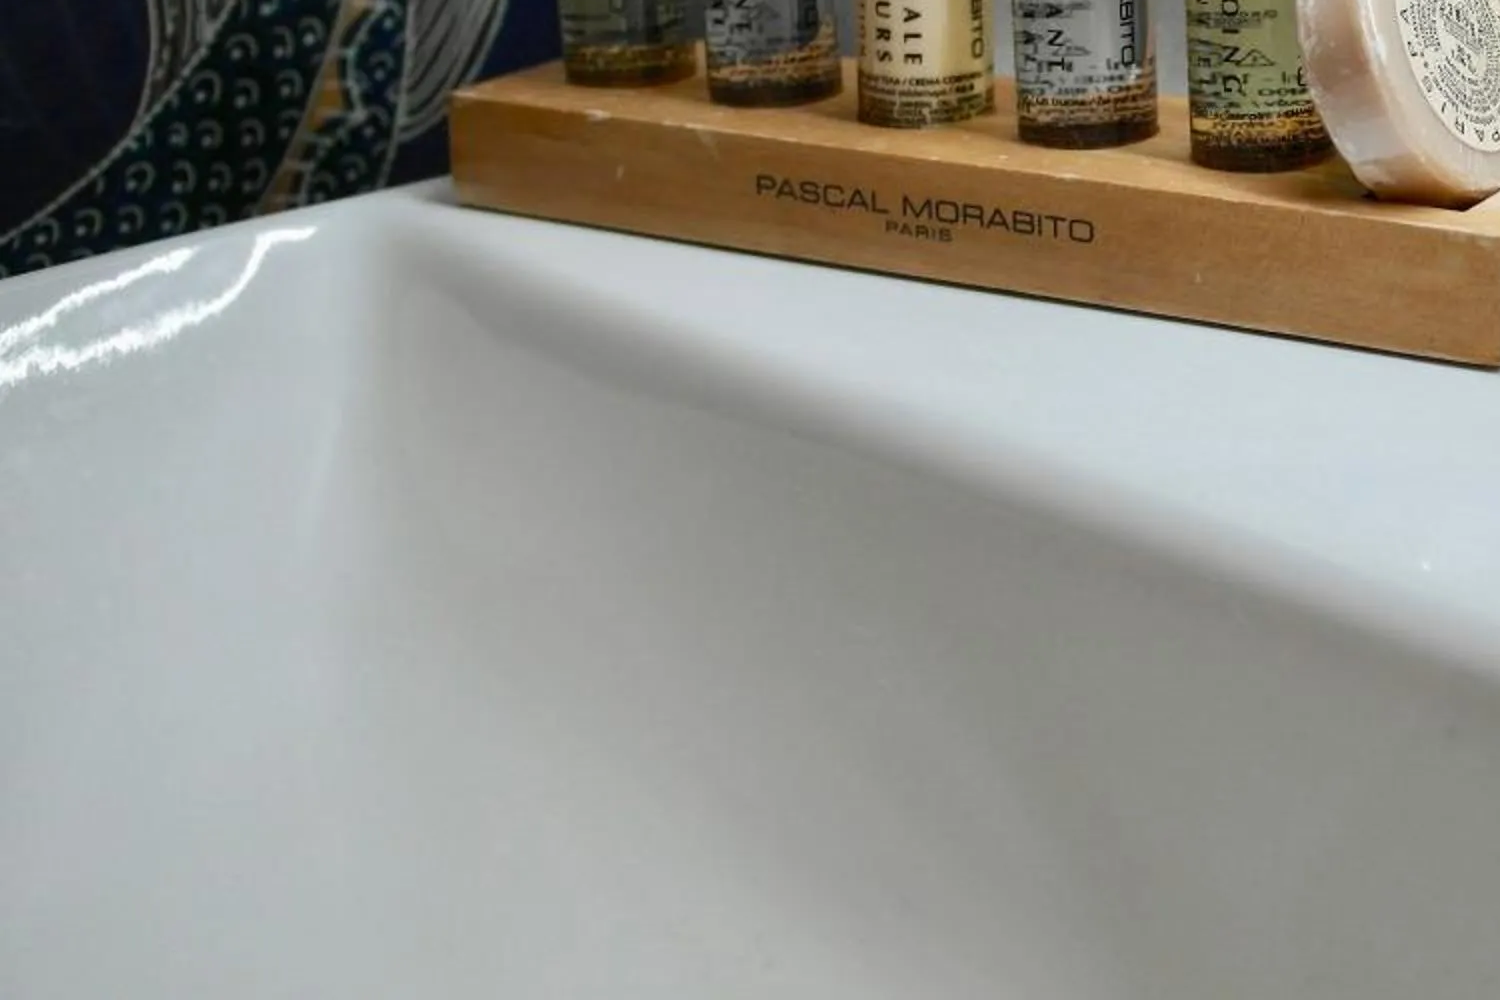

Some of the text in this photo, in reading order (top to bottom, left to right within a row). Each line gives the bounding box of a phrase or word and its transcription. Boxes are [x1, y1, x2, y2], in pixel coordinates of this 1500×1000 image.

[756, 175, 1095, 244] PASCAL MORABITO
[886, 220, 953, 243] PARIS
